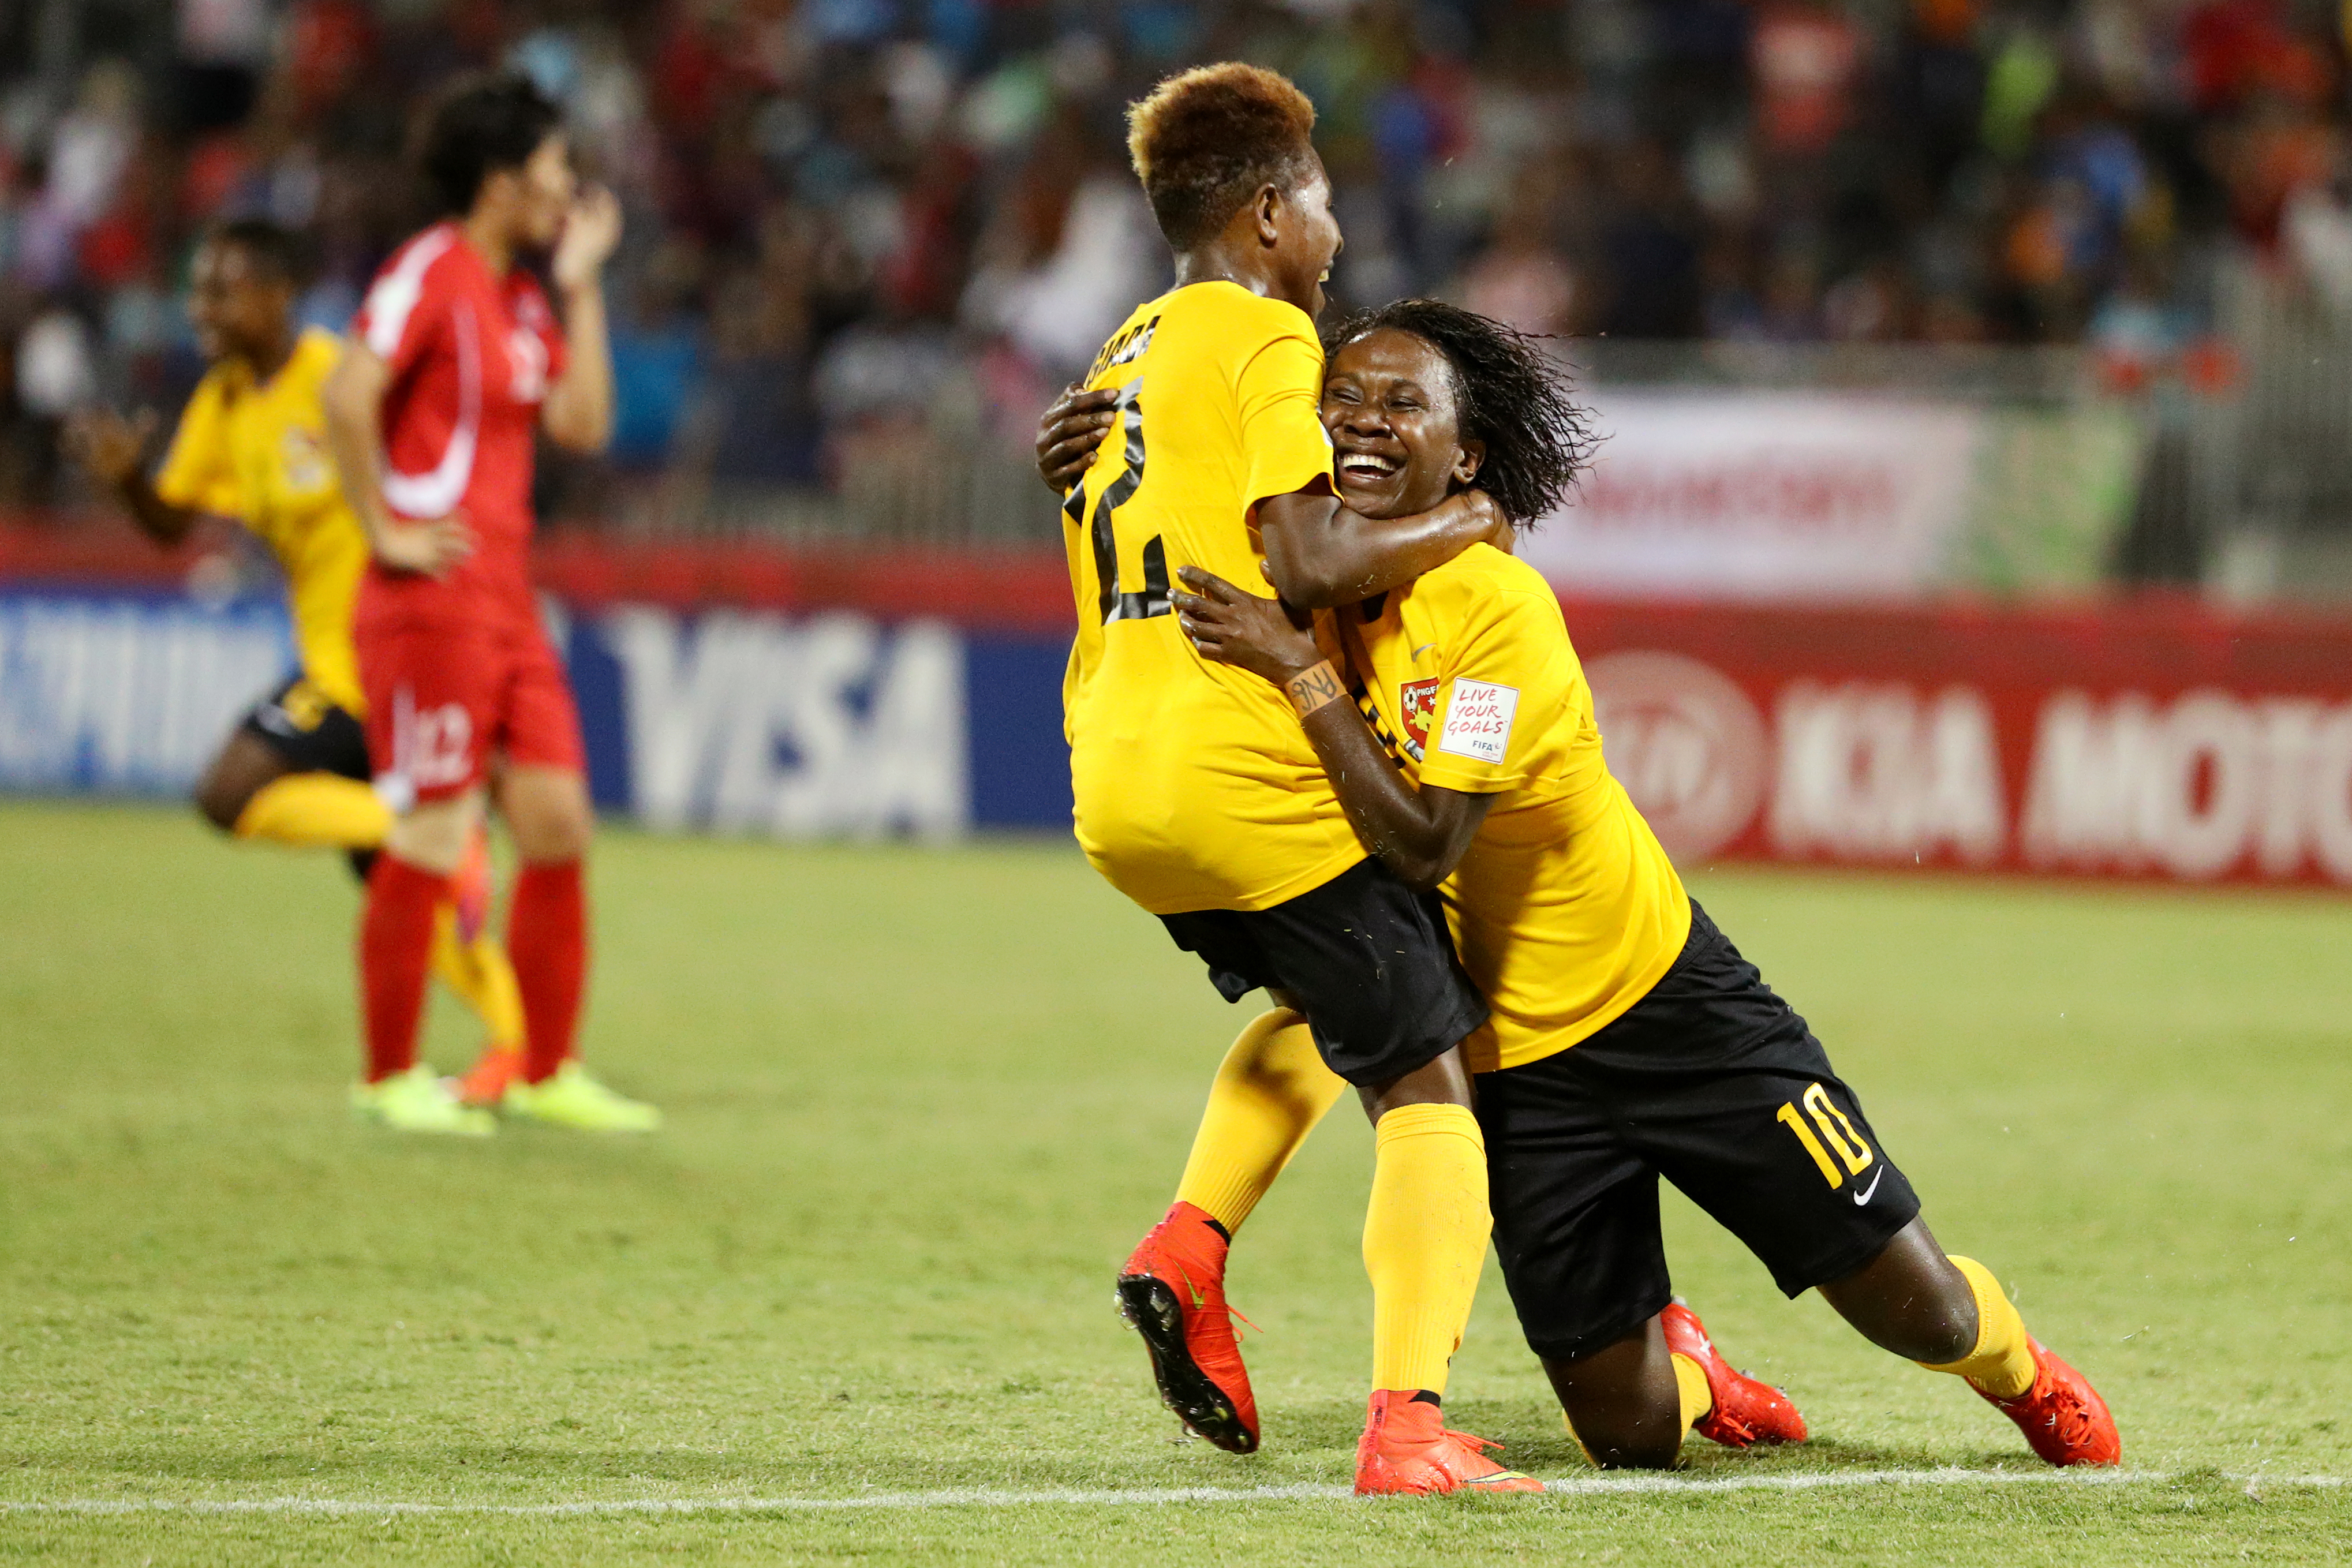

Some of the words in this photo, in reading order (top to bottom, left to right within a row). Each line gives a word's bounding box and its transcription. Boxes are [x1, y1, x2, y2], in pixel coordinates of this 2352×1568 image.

[1292, 665, 1337, 711] PNG
[1416, 684, 1439, 697] PNGF
[1459, 688, 1498, 701] LIVE
[606, 605, 971, 840] VISA
[1455, 705, 1502, 718] YOUR
[1448, 721, 1504, 736] GOALS
[1472, 740, 1493, 751] FIFA
[1773, 681, 2009, 854] KIA
[1777, 1082, 1874, 1190] 10
[1365, 1405, 1382, 1450] MERCRIAL
